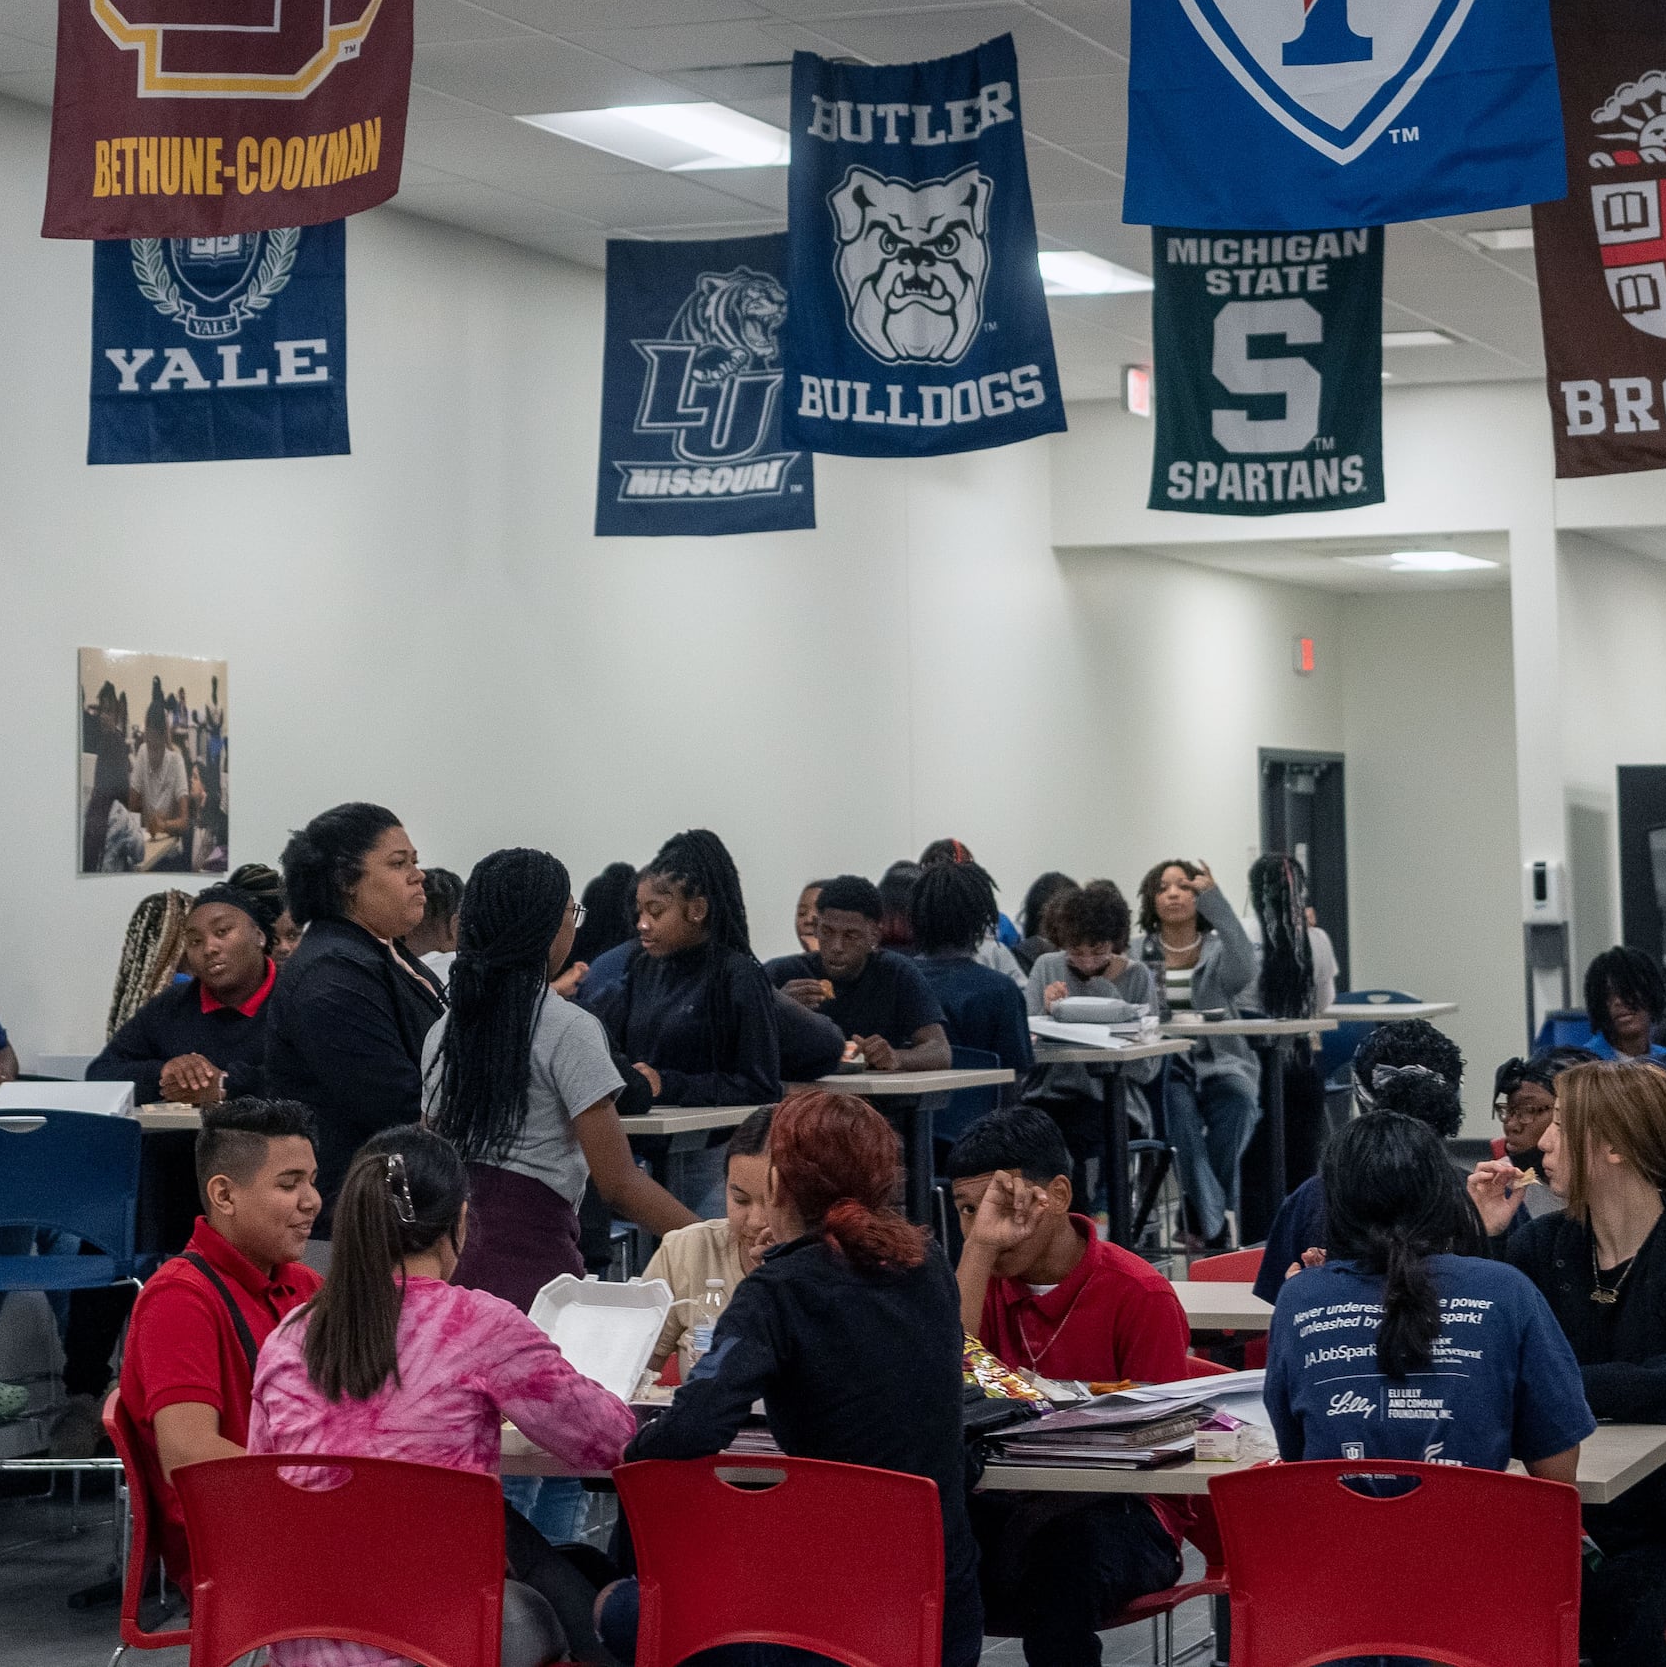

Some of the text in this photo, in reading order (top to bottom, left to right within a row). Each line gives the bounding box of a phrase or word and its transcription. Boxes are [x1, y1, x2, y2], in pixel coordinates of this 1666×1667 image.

[806, 80, 1015, 147] BUTLER
[92, 116, 383, 199] BETHUNE-COOKMAN
[1166, 227, 1369, 265] MICHIGAN
[1204, 263, 1330, 297] STATE
[193, 319, 233, 335] YALE
[105, 337, 332, 392] YALE
[1211, 297, 1323, 454] S
[797, 363, 1047, 428] BULLDOGS
[625, 458, 784, 496] MISSOURI
[1166, 453, 1365, 503] SPARTANS
[1293, 1305, 1325, 1326] Never
[1449, 1297, 1494, 1310] power
[1299, 1311, 1483, 1338] unleashed by spark!
[1428, 1344, 1484, 1360] chievement
[1326, 1390, 1377, 1419] Lilly
[1387, 1398, 1444, 1409] AND COMPANY
